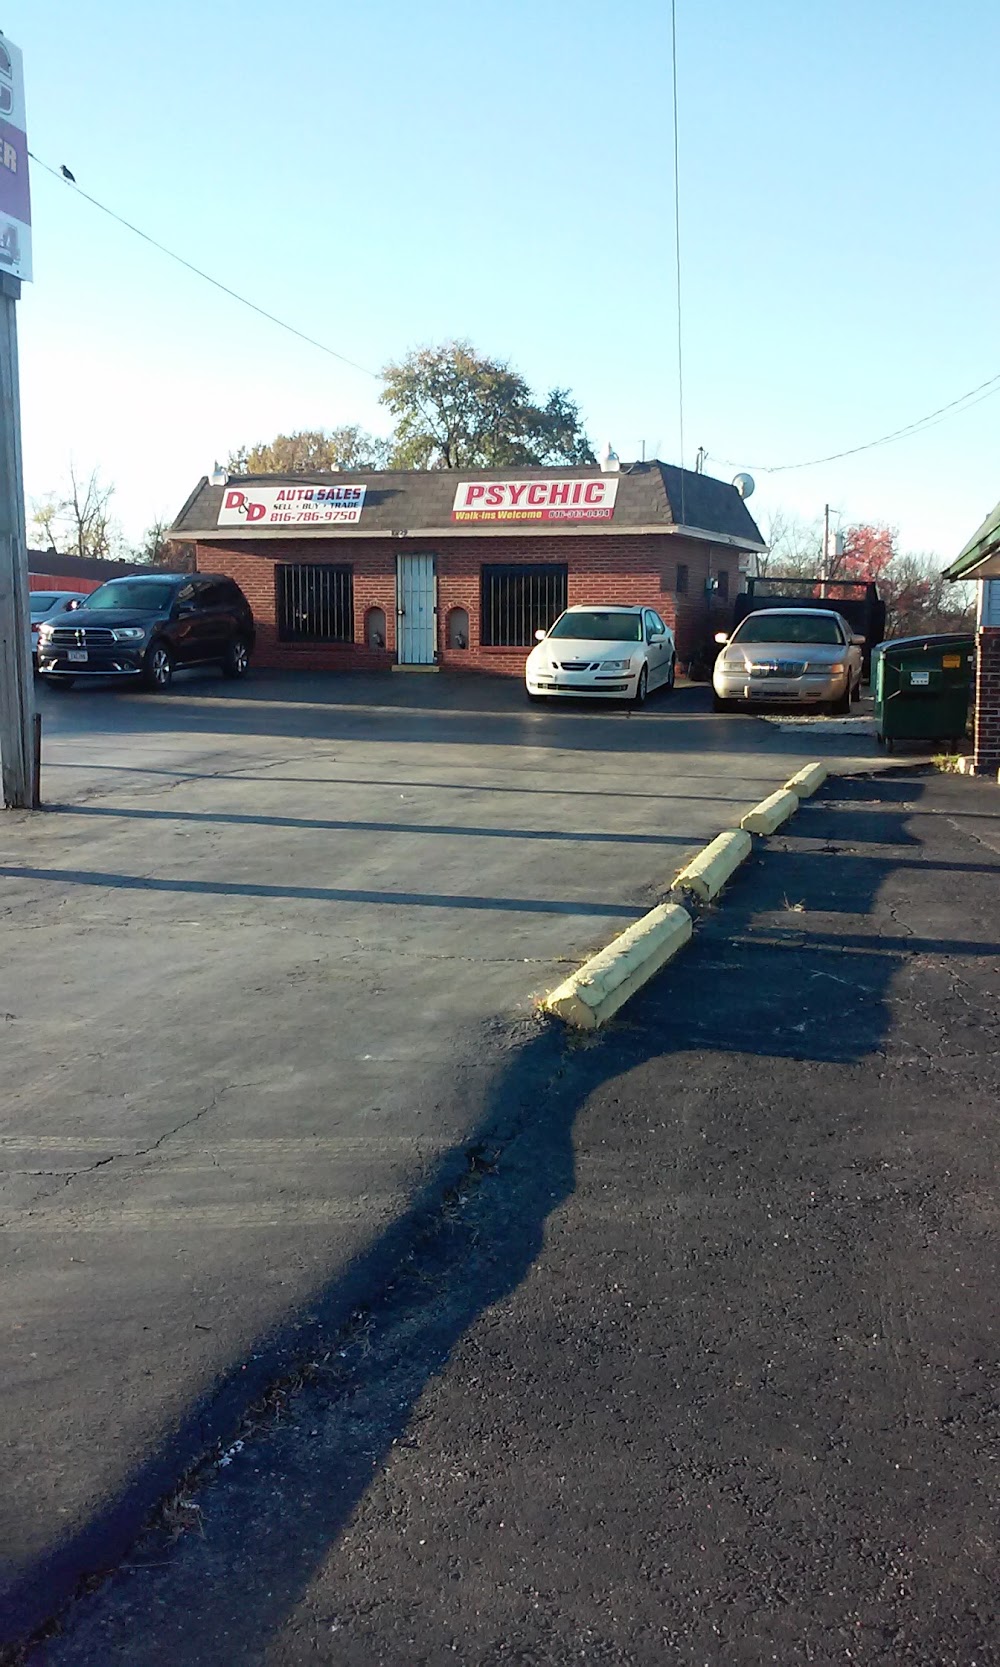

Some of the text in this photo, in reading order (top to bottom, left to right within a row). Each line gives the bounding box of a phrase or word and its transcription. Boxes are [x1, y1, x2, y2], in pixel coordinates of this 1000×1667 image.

[276, 488, 361, 501] AUTO SALES
[464, 483, 605, 505] PSYCHIC
[270, 511, 357, 522] 816-786-9750
[497, 510, 543, 519] Welcome
